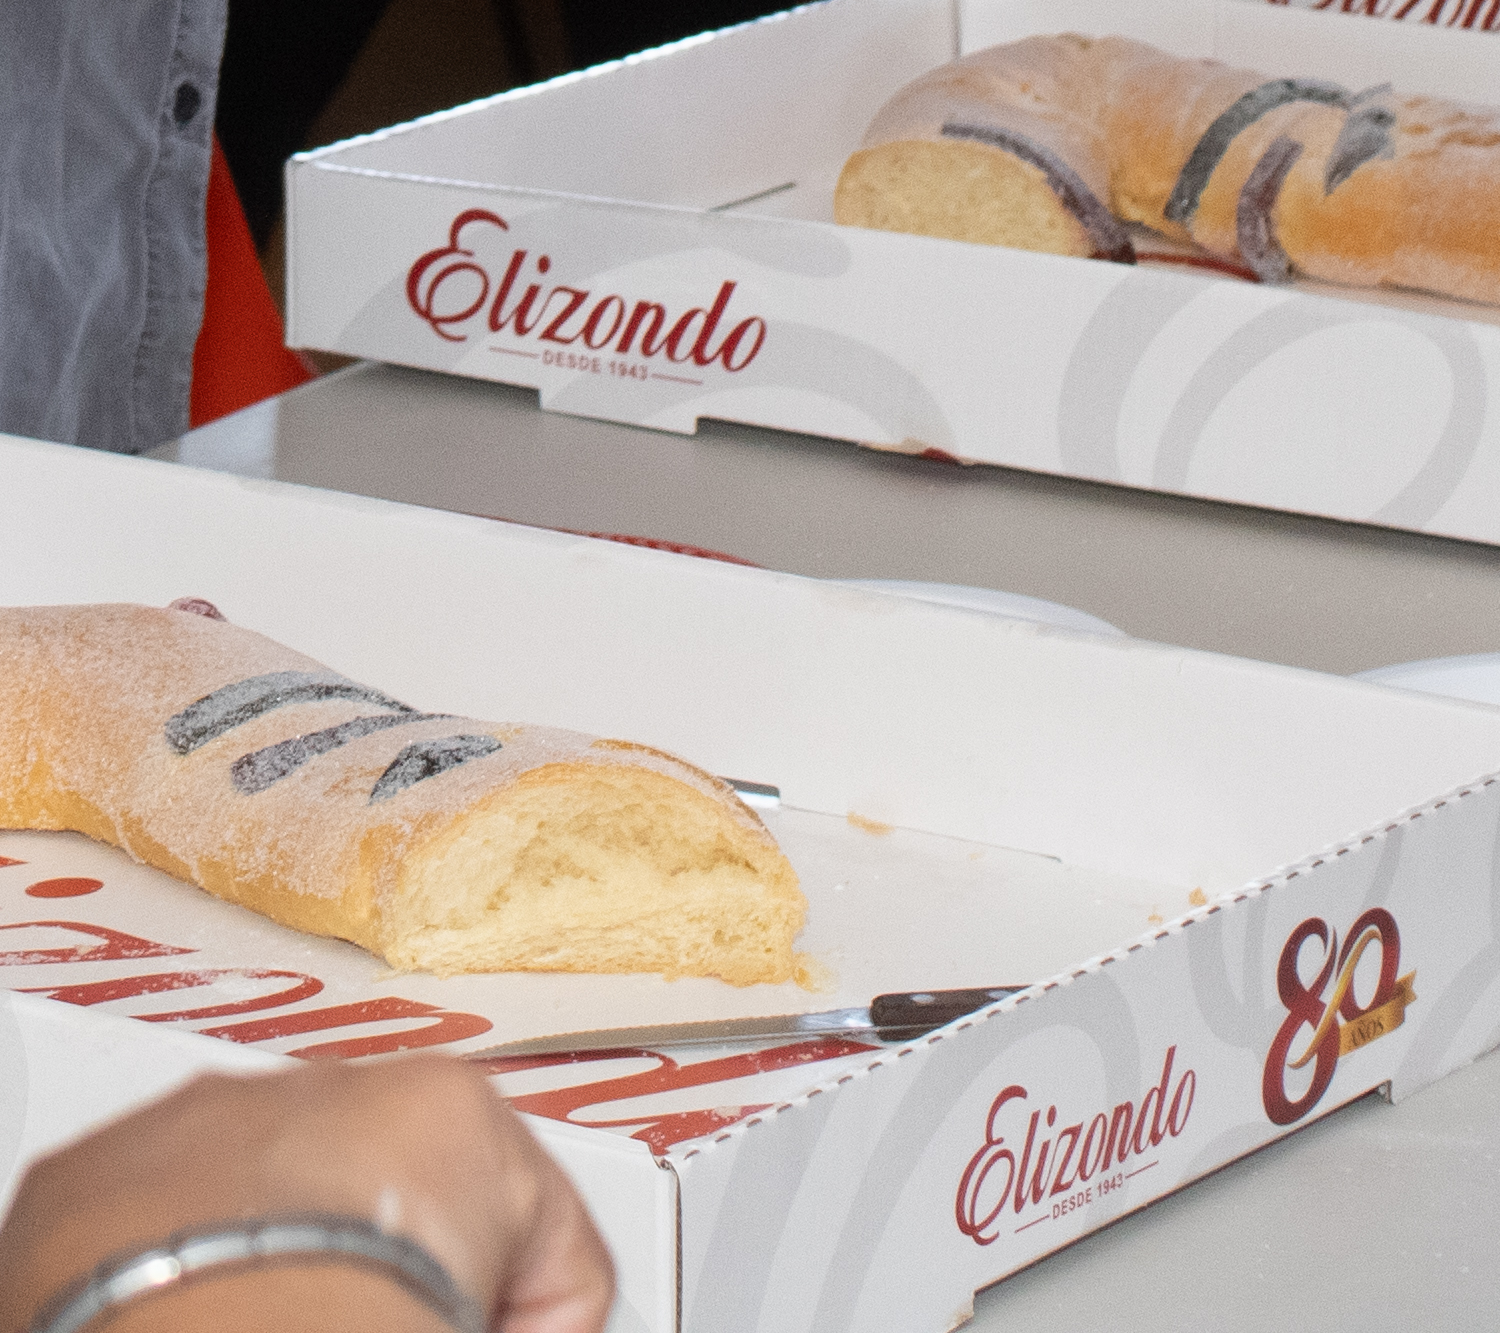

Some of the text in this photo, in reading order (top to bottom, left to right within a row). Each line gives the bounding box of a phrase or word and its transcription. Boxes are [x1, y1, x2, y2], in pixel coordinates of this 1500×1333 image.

[405, 208, 767, 373] Elizondo
[1261, 906, 1401, 1126] 80
[954, 1044, 1197, 1247] Elizondo
[1052, 1172, 1124, 1220] DESDE 1943
